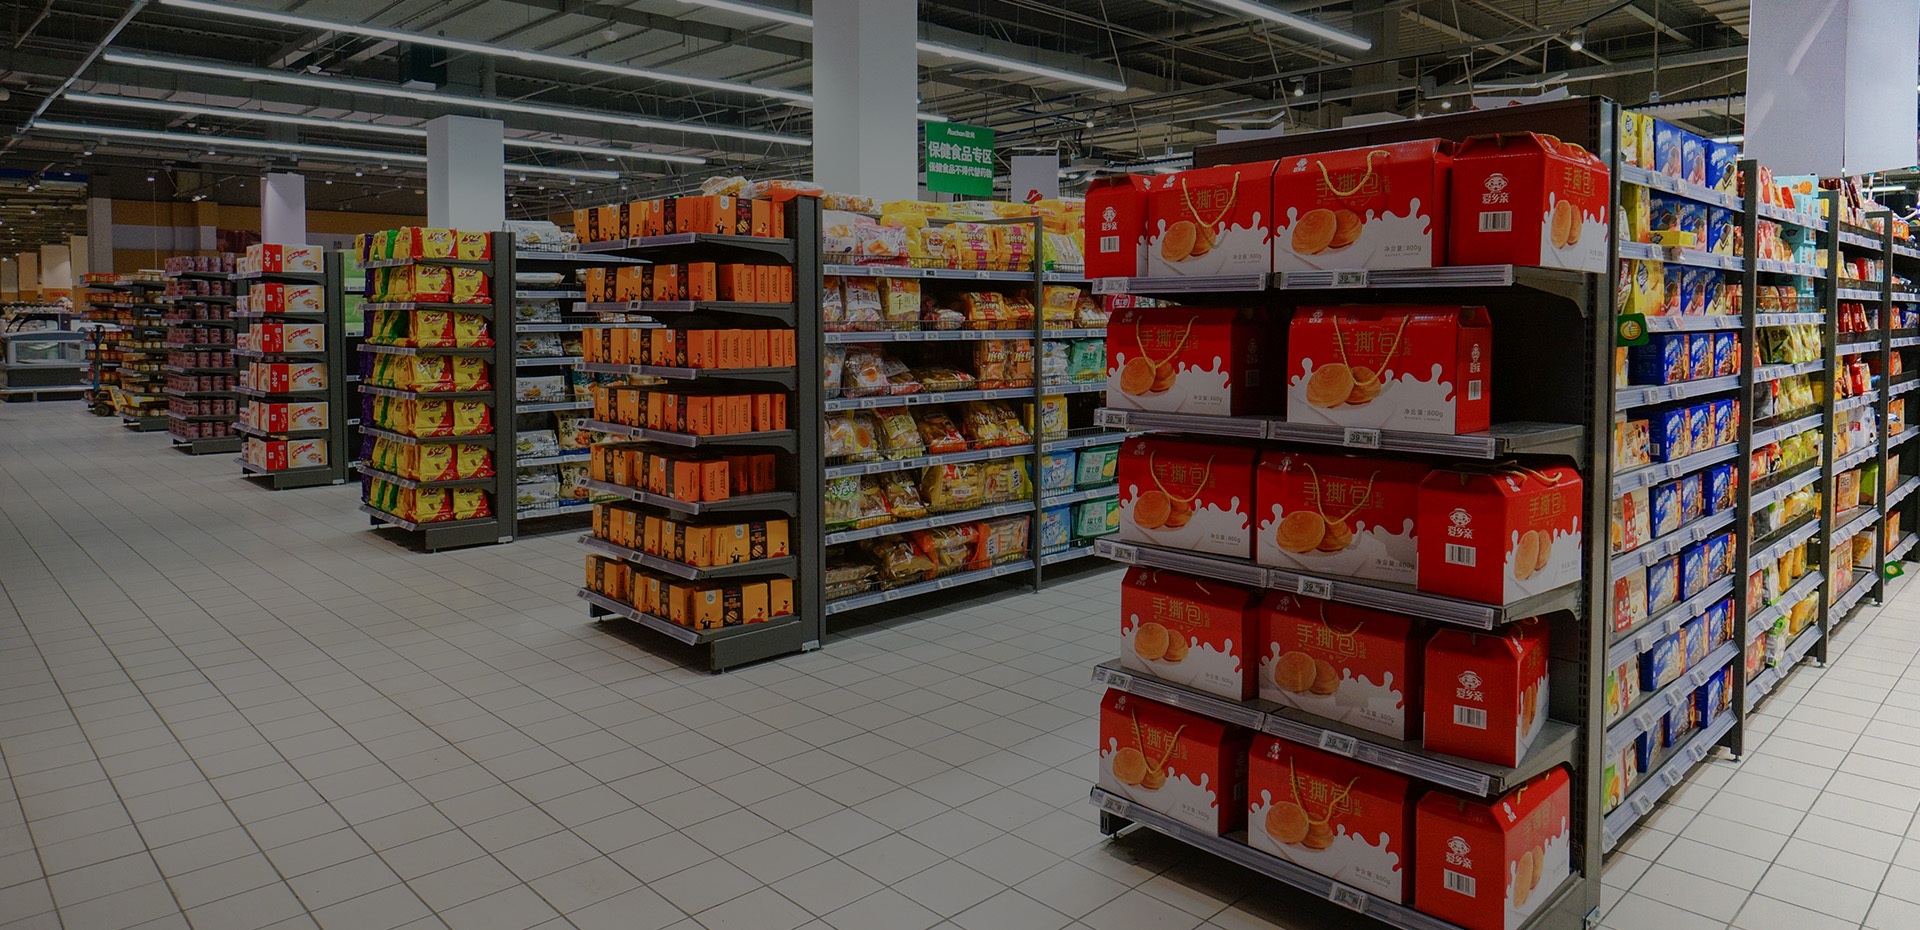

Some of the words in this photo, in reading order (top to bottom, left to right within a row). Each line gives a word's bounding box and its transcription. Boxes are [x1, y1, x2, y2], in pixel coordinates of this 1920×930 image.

[928, 140, 992, 164] 保健食品专区
[928, 161, 992, 178] 保健食品不得代替药物
[1316, 172, 1379, 198] 手撕包
[1180, 187, 1230, 210] 手撕包
[1482, 192, 1510, 204] 爱乡亲
[1101, 222, 1118, 231] 爱乡亲
[1339, 274, 1349, 283] 39
[1140, 328, 1189, 349] 手撕包
[1332, 331, 1398, 353] 手撕包
[1350, 433, 1360, 441] 39
[1154, 463, 1206, 486] 手撕包
[1303, 481, 1370, 507] 手撕包
[1529, 492, 1562, 518] 手撕包
[1448, 525, 1474, 539] 爱乡亲
[1304, 582, 1314, 590] 39
[1152, 596, 1201, 624] 手撕包
[1297, 623, 1355, 655] 手撕包
[1456, 687, 1484, 702] 爱乡亲
[1131, 722, 1177, 755] 手撕包
[1289, 773, 1350, 809] 手撕包
[1446, 851, 1473, 870] 爱乡亲
